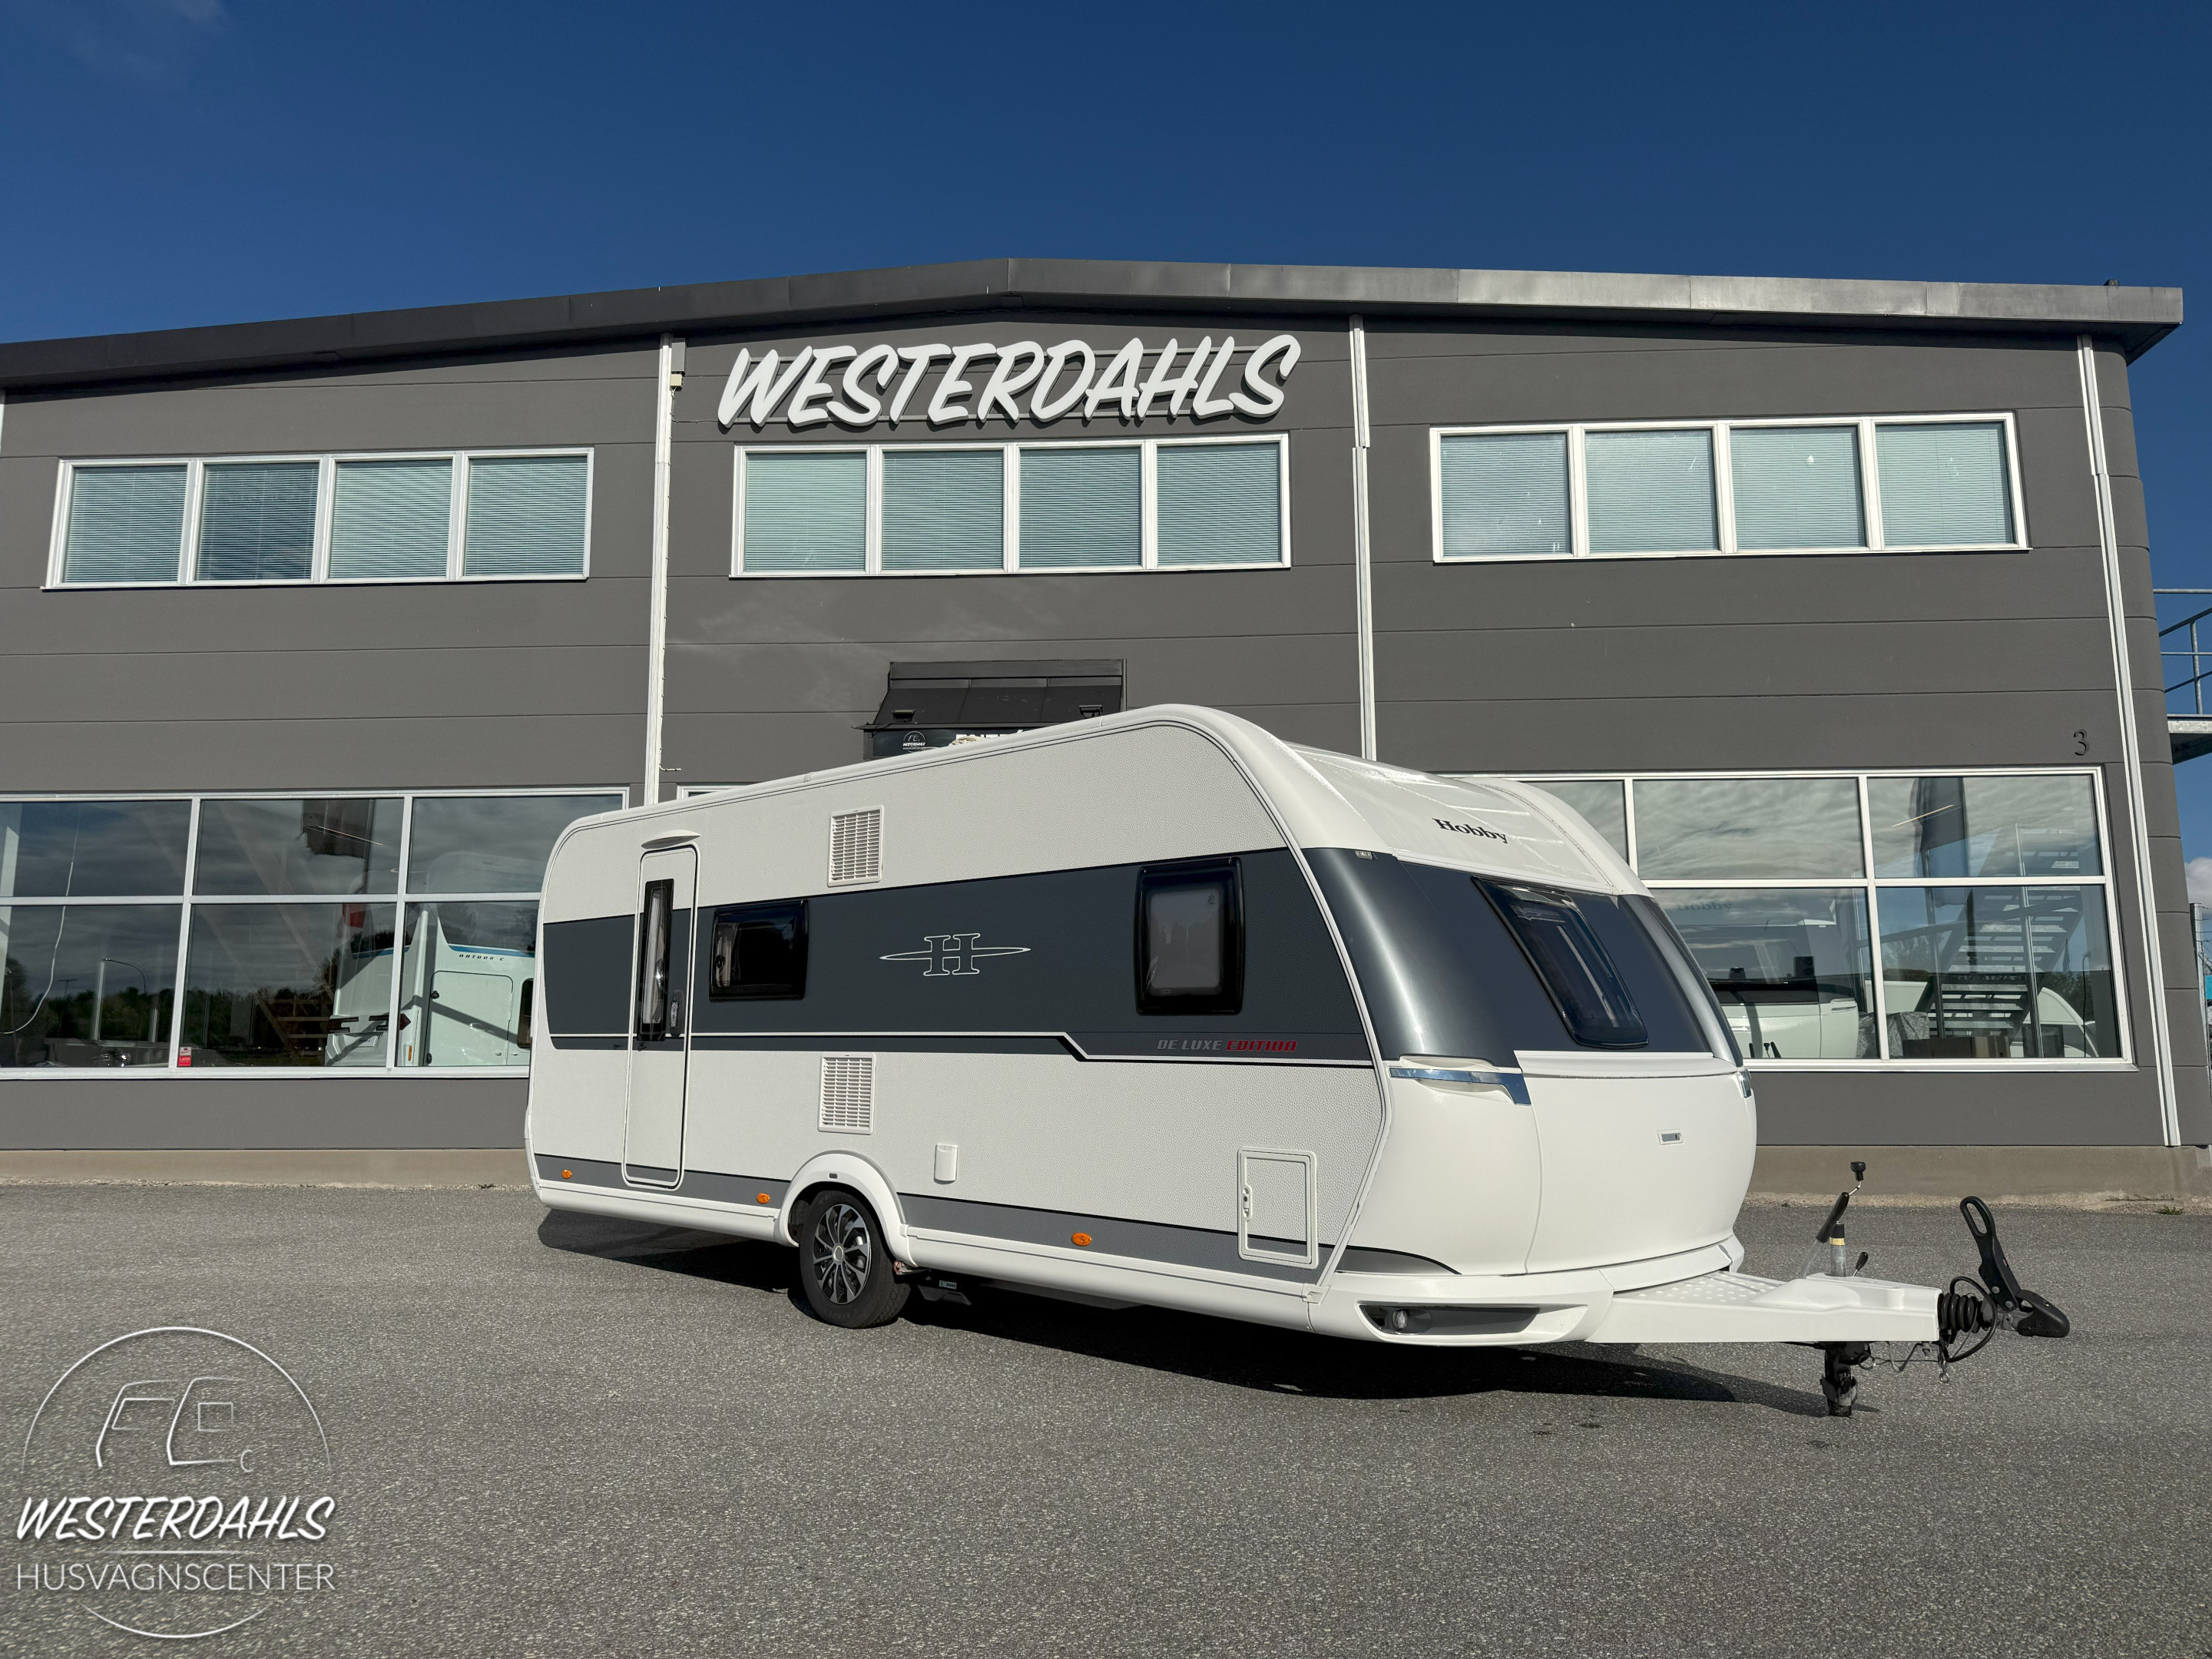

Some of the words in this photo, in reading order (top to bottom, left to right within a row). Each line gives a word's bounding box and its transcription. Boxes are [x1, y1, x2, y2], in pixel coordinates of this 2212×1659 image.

[717, 335, 1301, 428] WESTERDAHLS
[2074, 729, 2089, 756] 3
[1432, 818, 1508, 843] Hobby
[1157, 1039, 1178, 1050] DE
[1181, 1040, 1223, 1051] LUXE
[1226, 1040, 1297, 1052] EDITION
